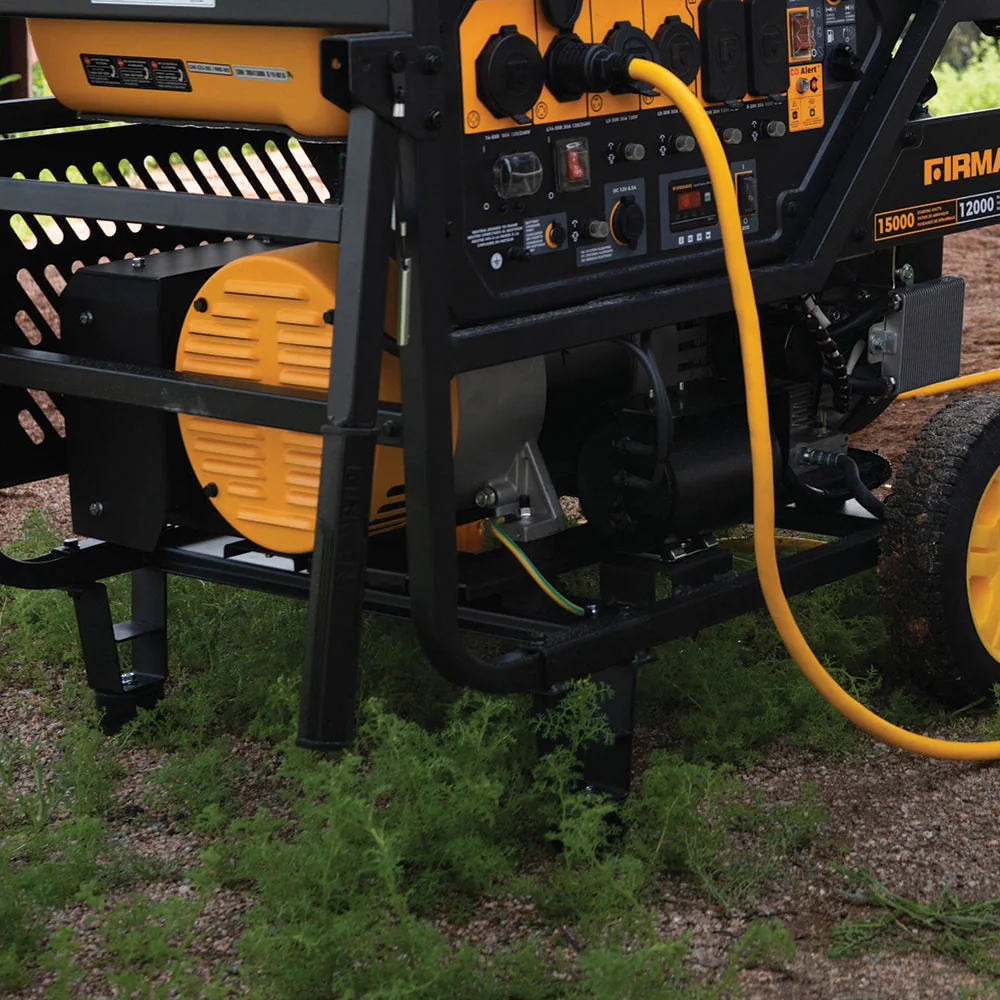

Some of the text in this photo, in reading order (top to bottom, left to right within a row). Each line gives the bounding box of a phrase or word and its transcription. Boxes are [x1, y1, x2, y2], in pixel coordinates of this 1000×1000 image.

[801, 66, 817, 75] Alert
[959, 196, 994, 218] 12000
[878, 212, 915, 234] 15000
